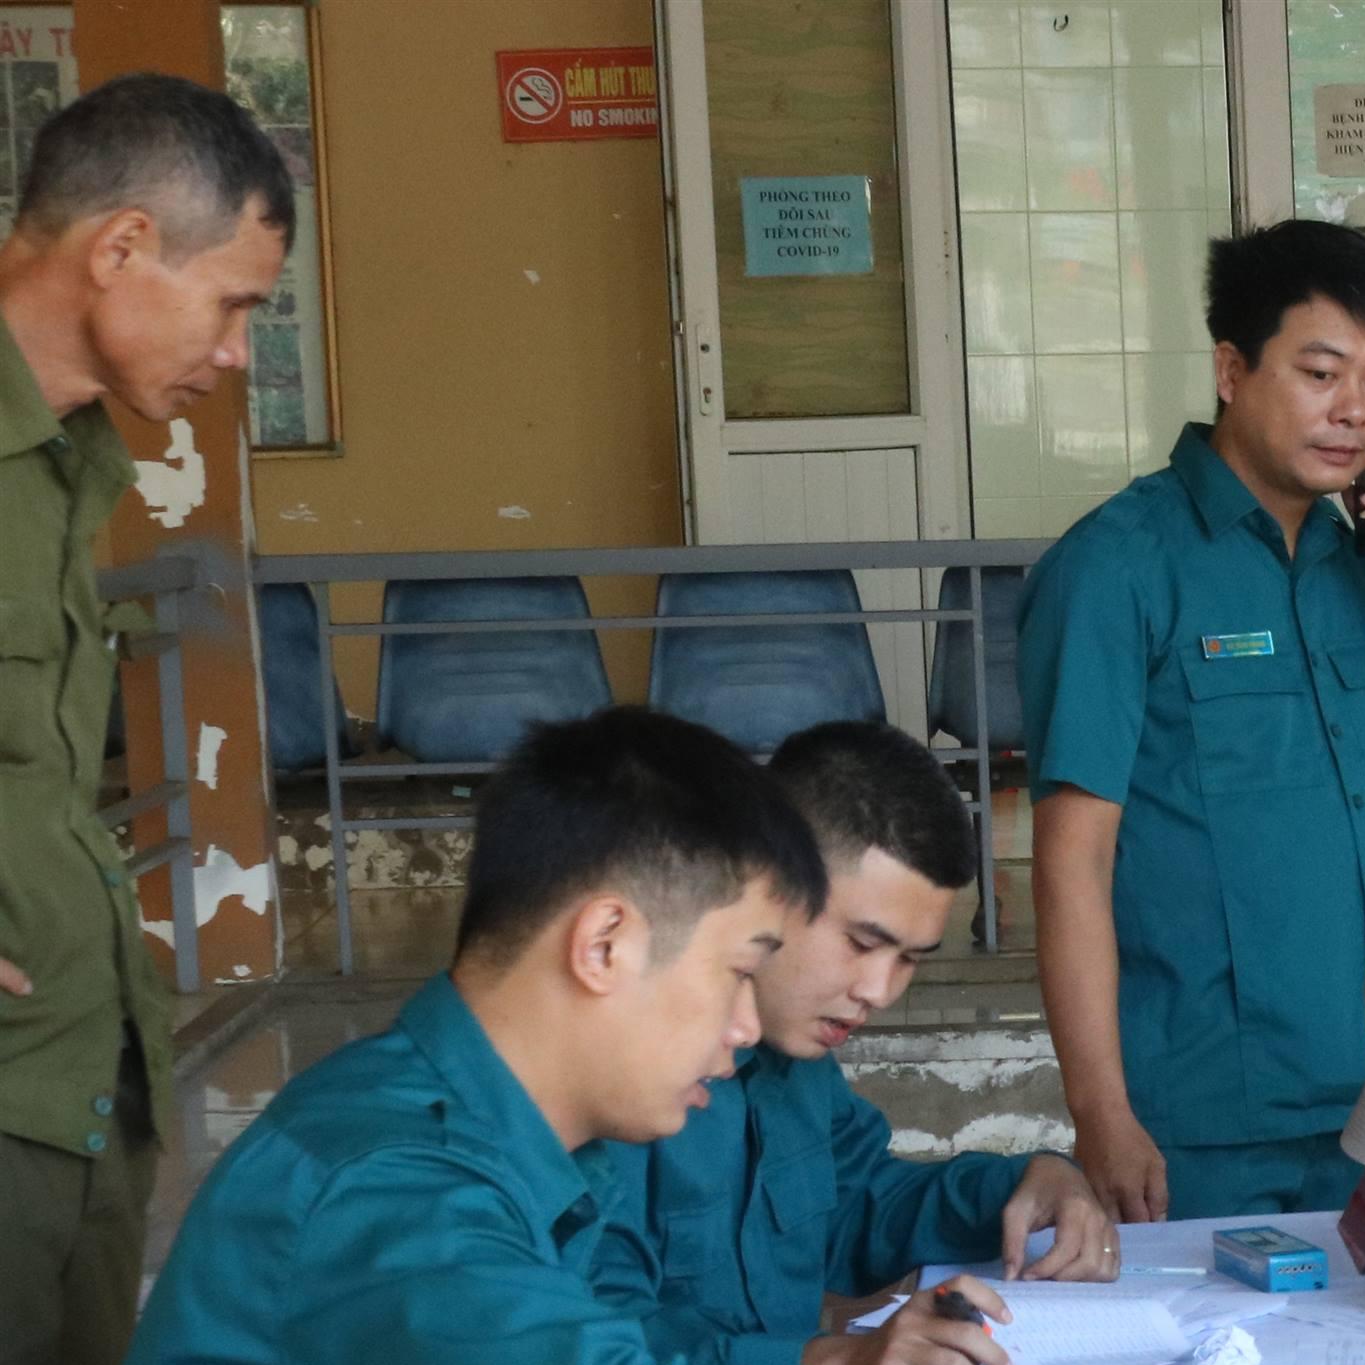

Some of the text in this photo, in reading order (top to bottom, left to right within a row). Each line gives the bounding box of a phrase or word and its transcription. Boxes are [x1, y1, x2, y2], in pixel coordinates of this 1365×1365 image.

[571, 109, 593, 127] NO
[814, 190, 851, 202] THEO
[807, 209, 832, 220] SAU
[777, 245, 840, 258] COVID-19
